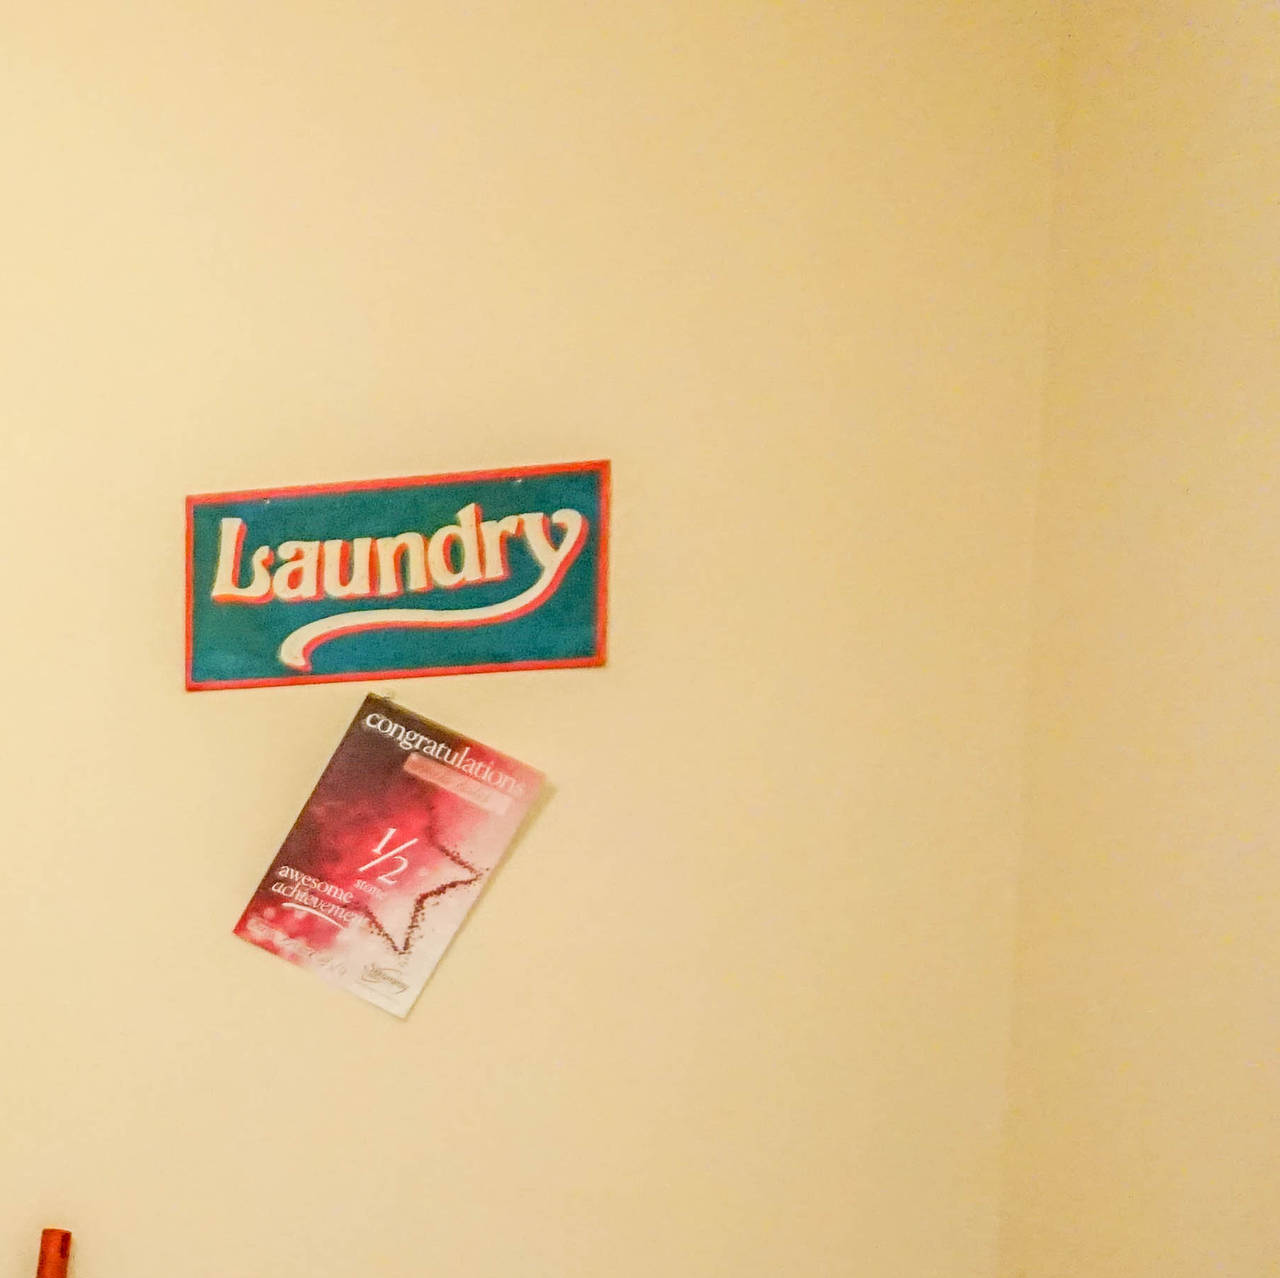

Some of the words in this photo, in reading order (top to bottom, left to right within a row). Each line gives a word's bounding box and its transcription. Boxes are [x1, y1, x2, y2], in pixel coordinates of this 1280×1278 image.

[211, 503, 589, 673] Laundry
[366, 713, 527, 796] congratulations
[278, 865, 354, 904] awesome
[358, 827, 419, 885] 1/2
